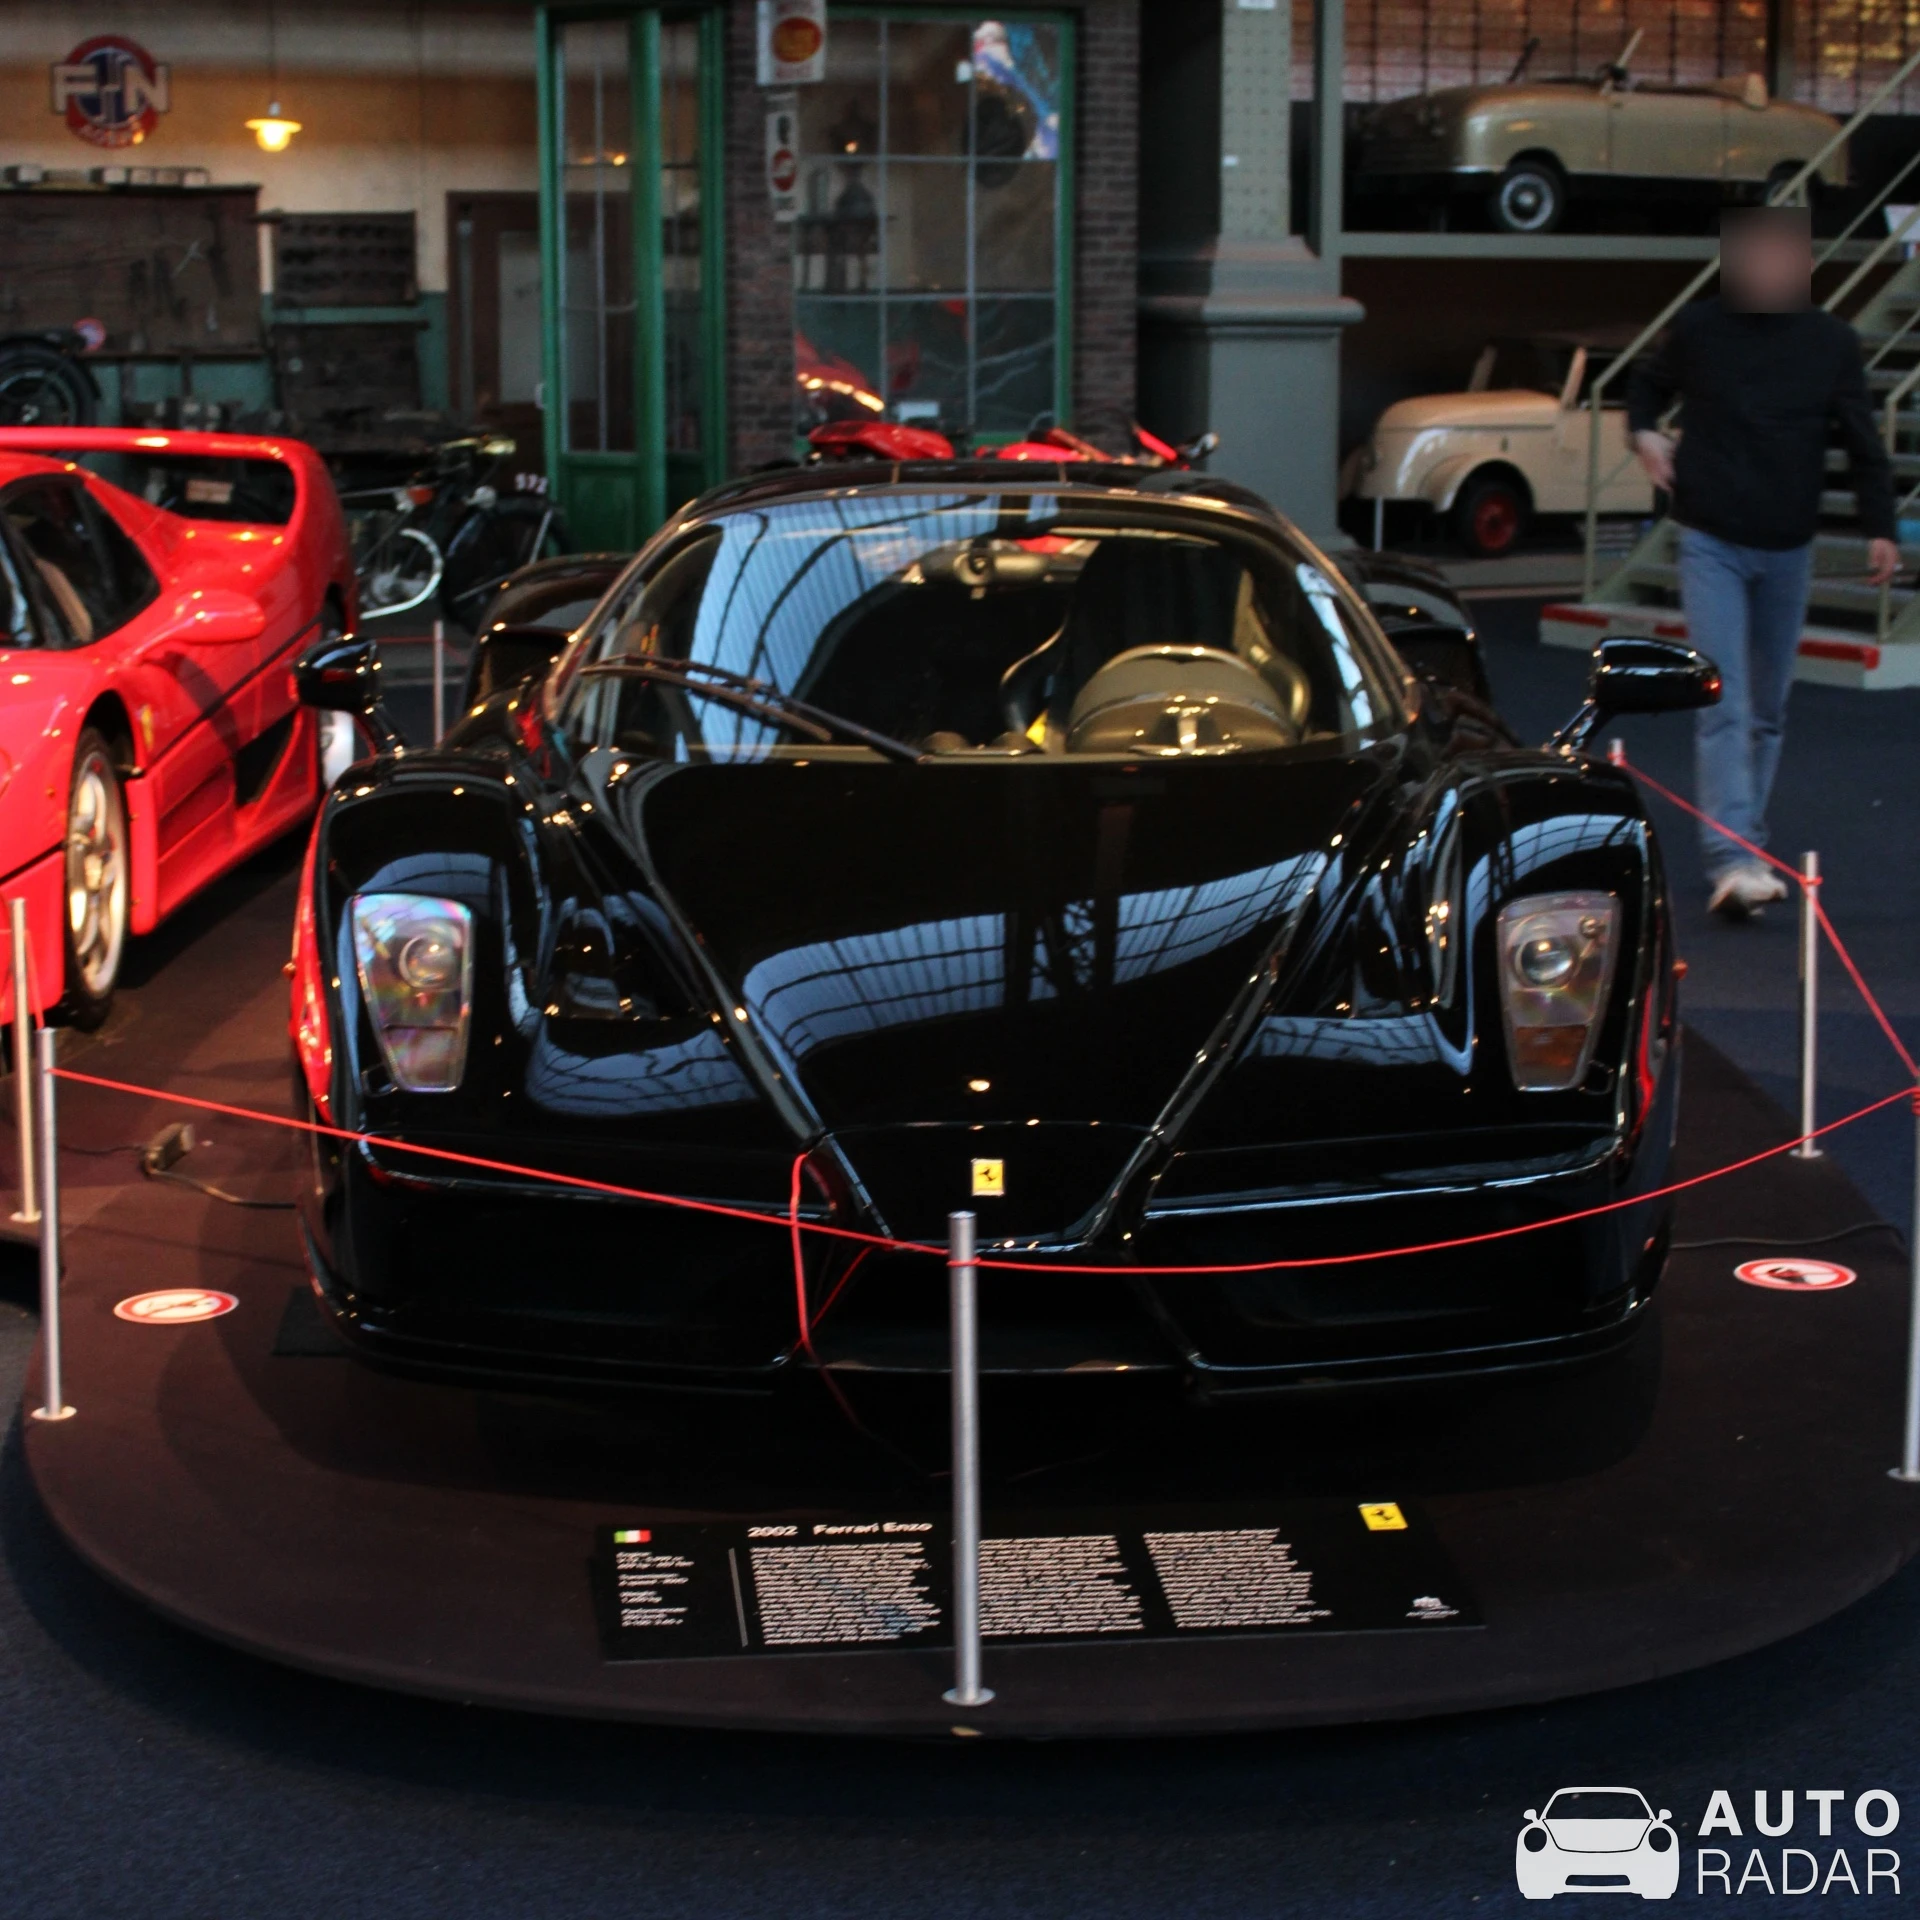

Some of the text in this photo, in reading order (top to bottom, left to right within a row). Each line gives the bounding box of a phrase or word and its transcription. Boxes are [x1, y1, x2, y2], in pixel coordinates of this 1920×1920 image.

[748, 1522, 933, 1538] 2002 Ferrari Enzo
